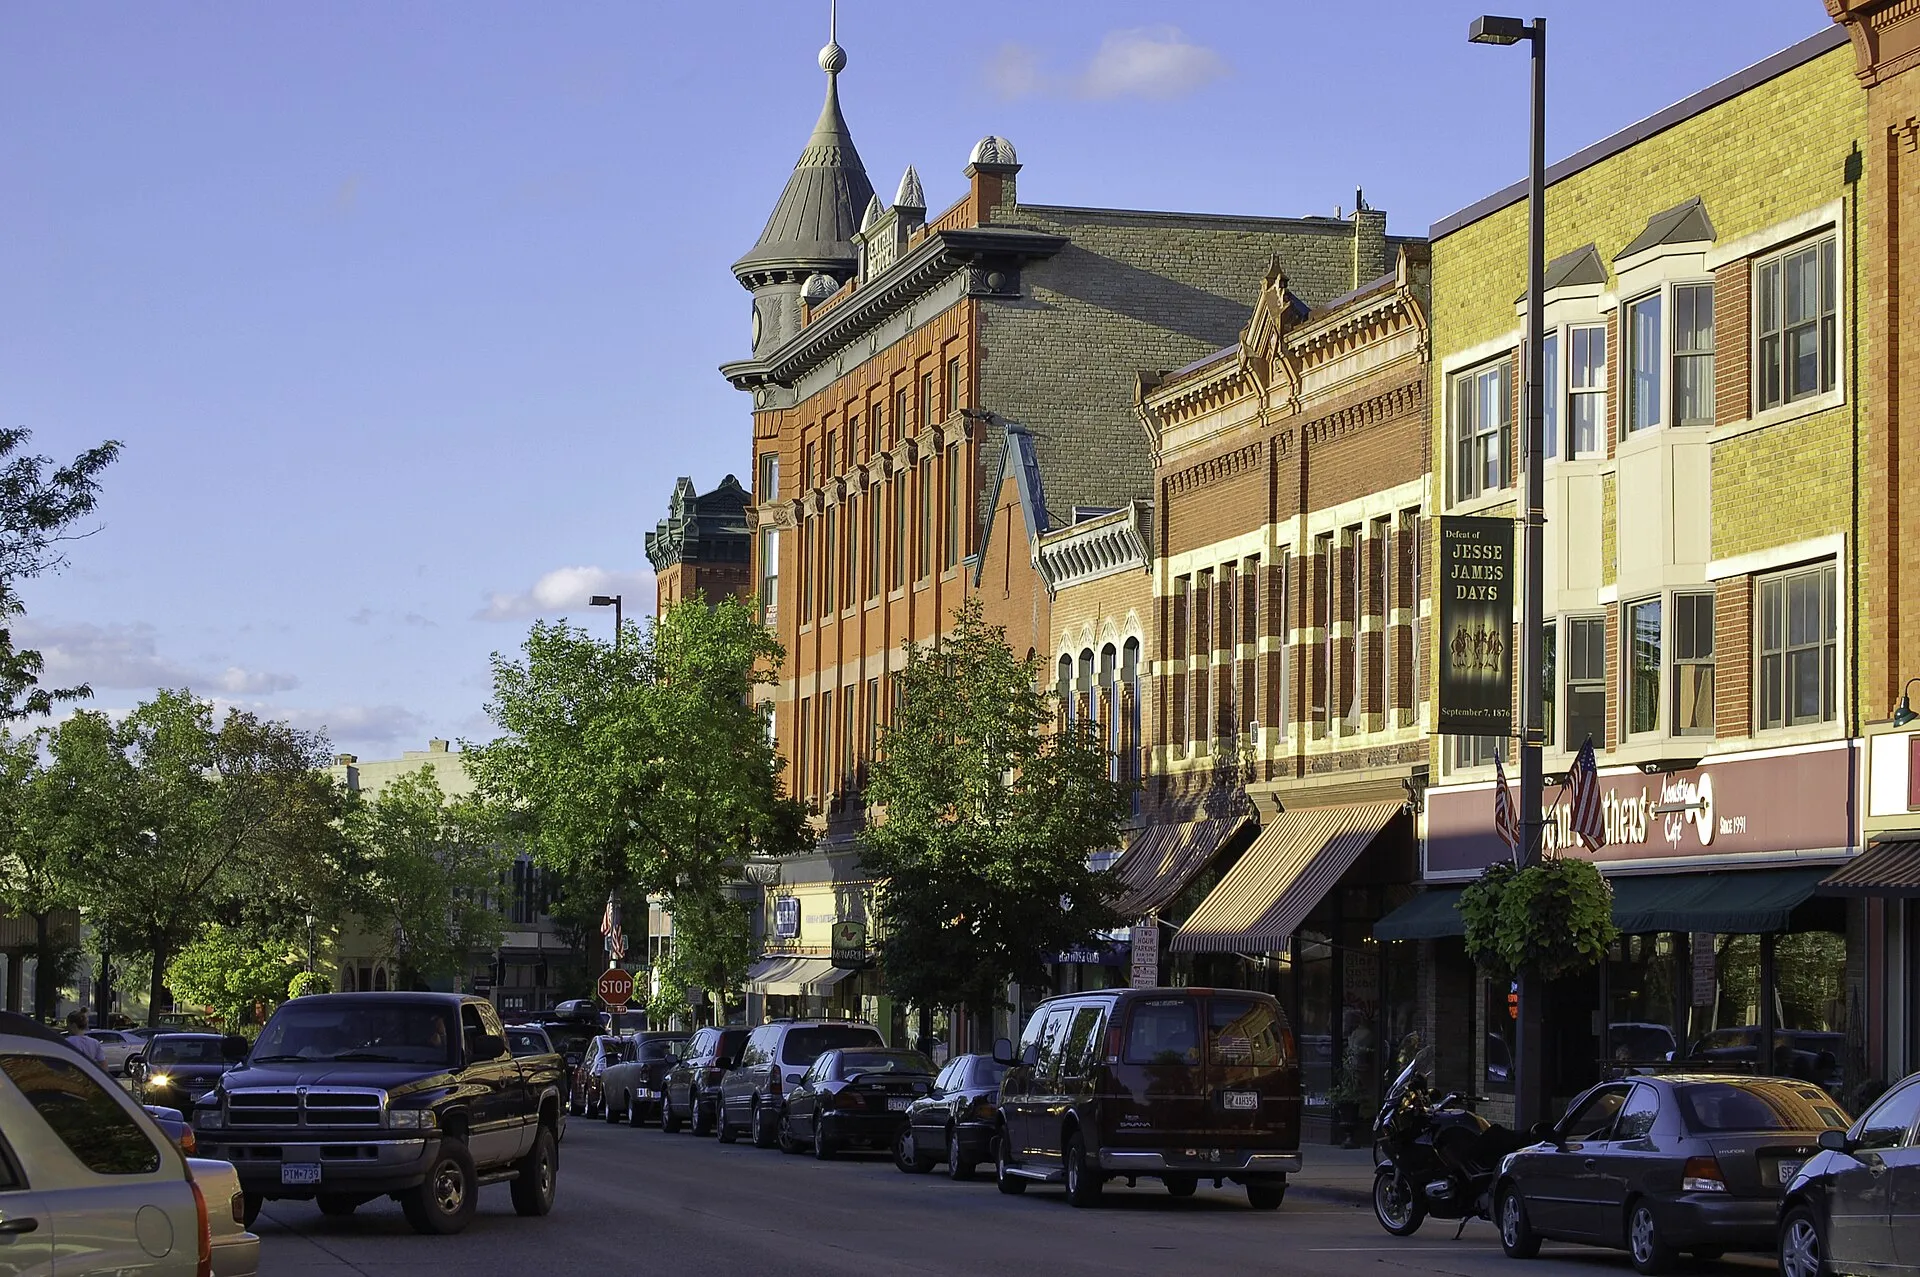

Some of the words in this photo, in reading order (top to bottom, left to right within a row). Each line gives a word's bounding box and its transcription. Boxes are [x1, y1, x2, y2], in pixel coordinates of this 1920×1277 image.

[1445, 530, 1470, 539] Defeat
[1472, 531, 1480, 539] of
[1452, 544, 1502, 560] JESSE
[1451, 564, 1504, 581] JAMES
[1456, 585, 1498, 601] DAYS
[1441, 706, 1483, 717] September
[1483, 708, 1491, 717] 7,
[1493, 709, 1511, 717] 1876
[1733, 816, 1746, 834] 1991
[1137, 937, 1154, 945] HOUR
[600, 980, 632, 994] STOP
